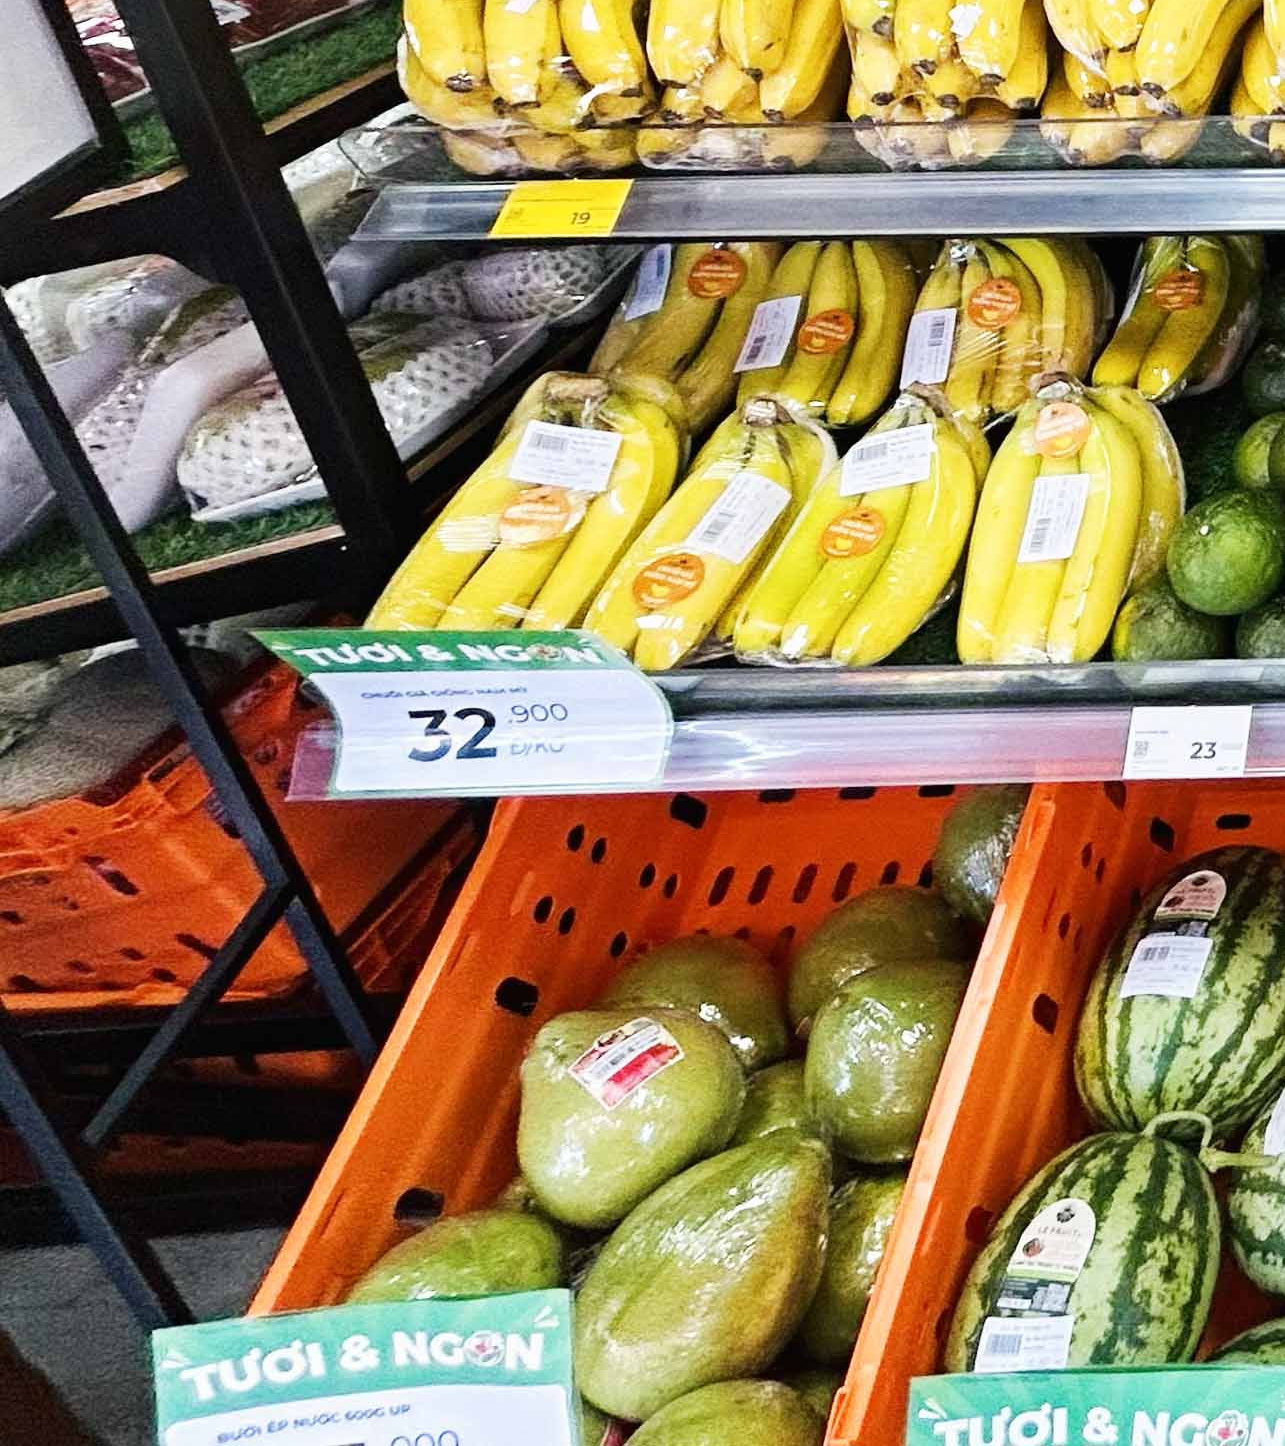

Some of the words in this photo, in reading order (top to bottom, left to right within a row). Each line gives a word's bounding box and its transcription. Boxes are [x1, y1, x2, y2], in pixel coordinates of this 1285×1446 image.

[570, 211, 591, 225] 19
[295, 642, 409, 667] TƯƠI
[417, 645, 455, 661] &
[408, 707, 497, 763] 32
[1189, 742, 1217, 759] 23
[180, 1338, 325, 1401] TƯƠI
[340, 1334, 380, 1372] &
[392, 1330, 544, 1370] NGON
[934, 1403, 1067, 1446] TƯƠI
[1082, 1406, 1118, 1445] &
